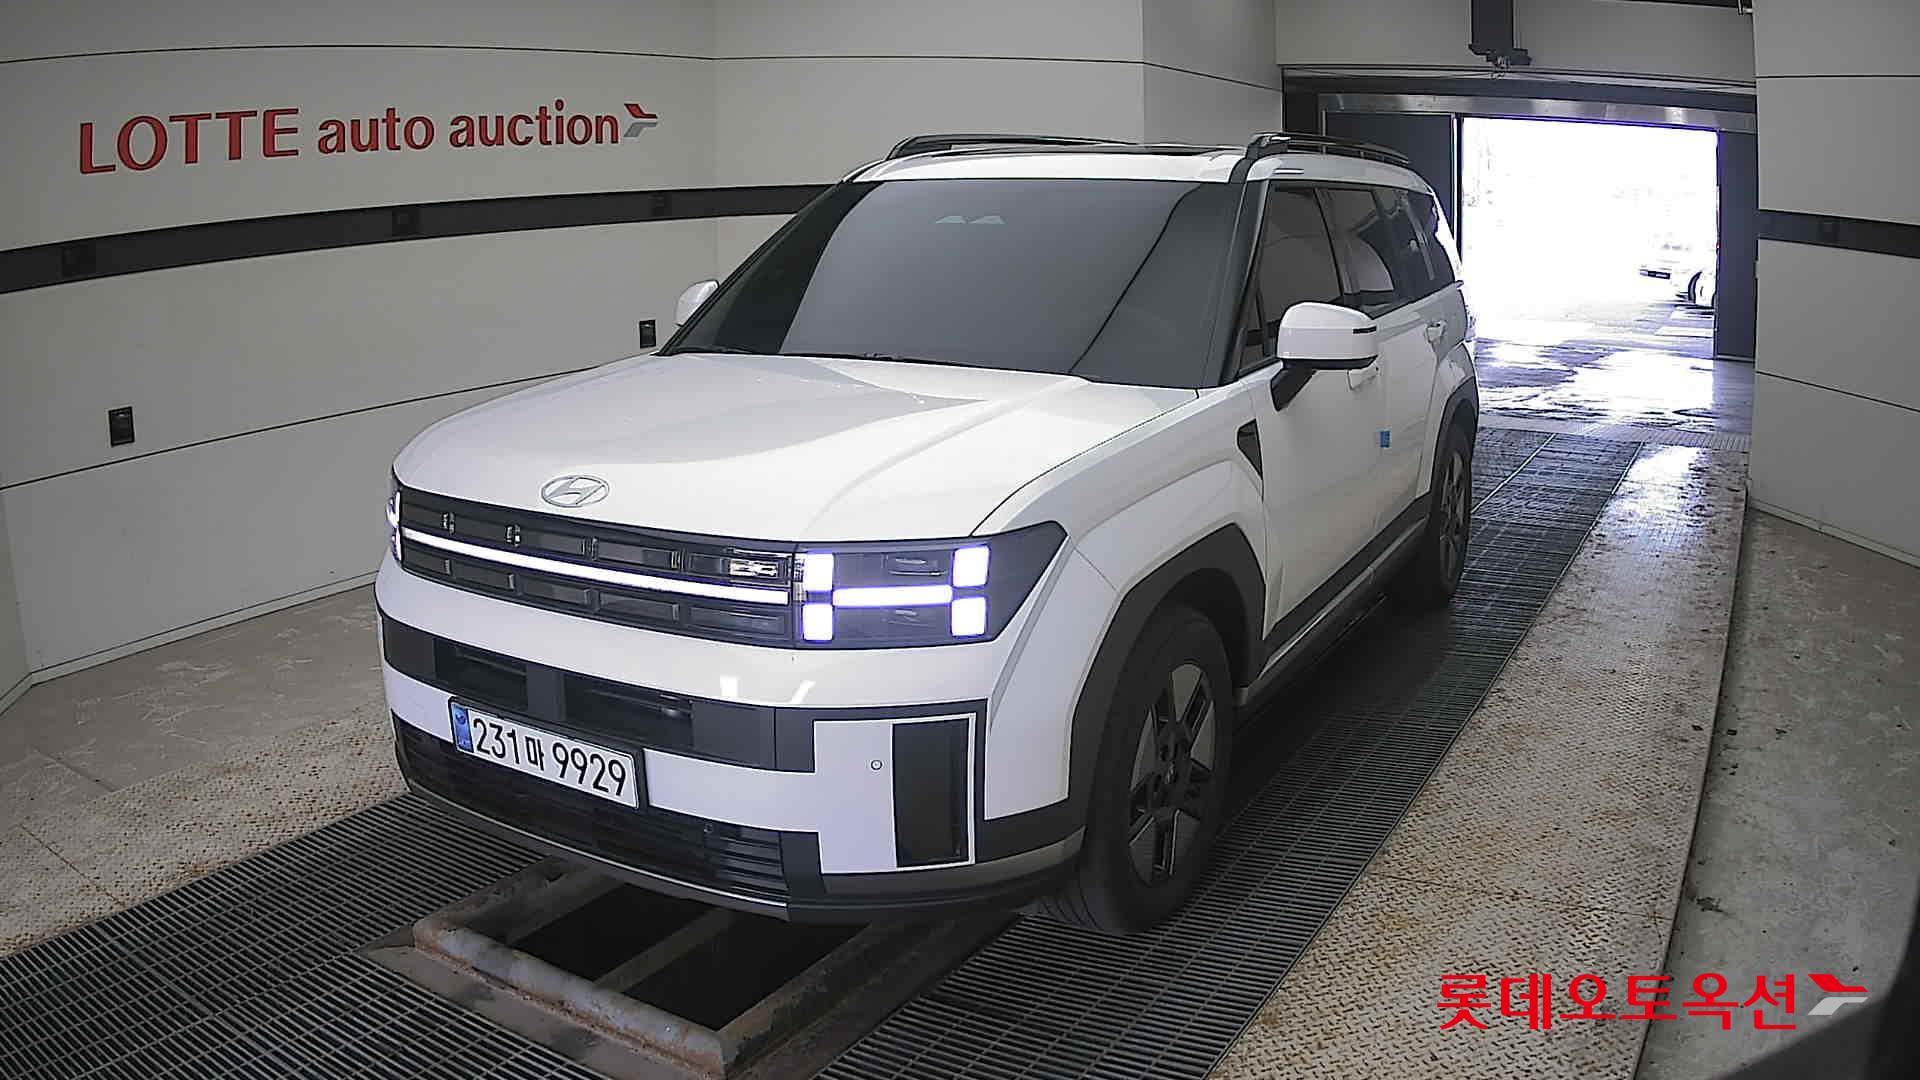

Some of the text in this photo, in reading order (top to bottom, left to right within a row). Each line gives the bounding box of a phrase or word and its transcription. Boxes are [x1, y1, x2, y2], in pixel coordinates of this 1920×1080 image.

[79, 99, 620, 175] LOTTE auto auction
[473, 718, 627, 797] 231마 9929
